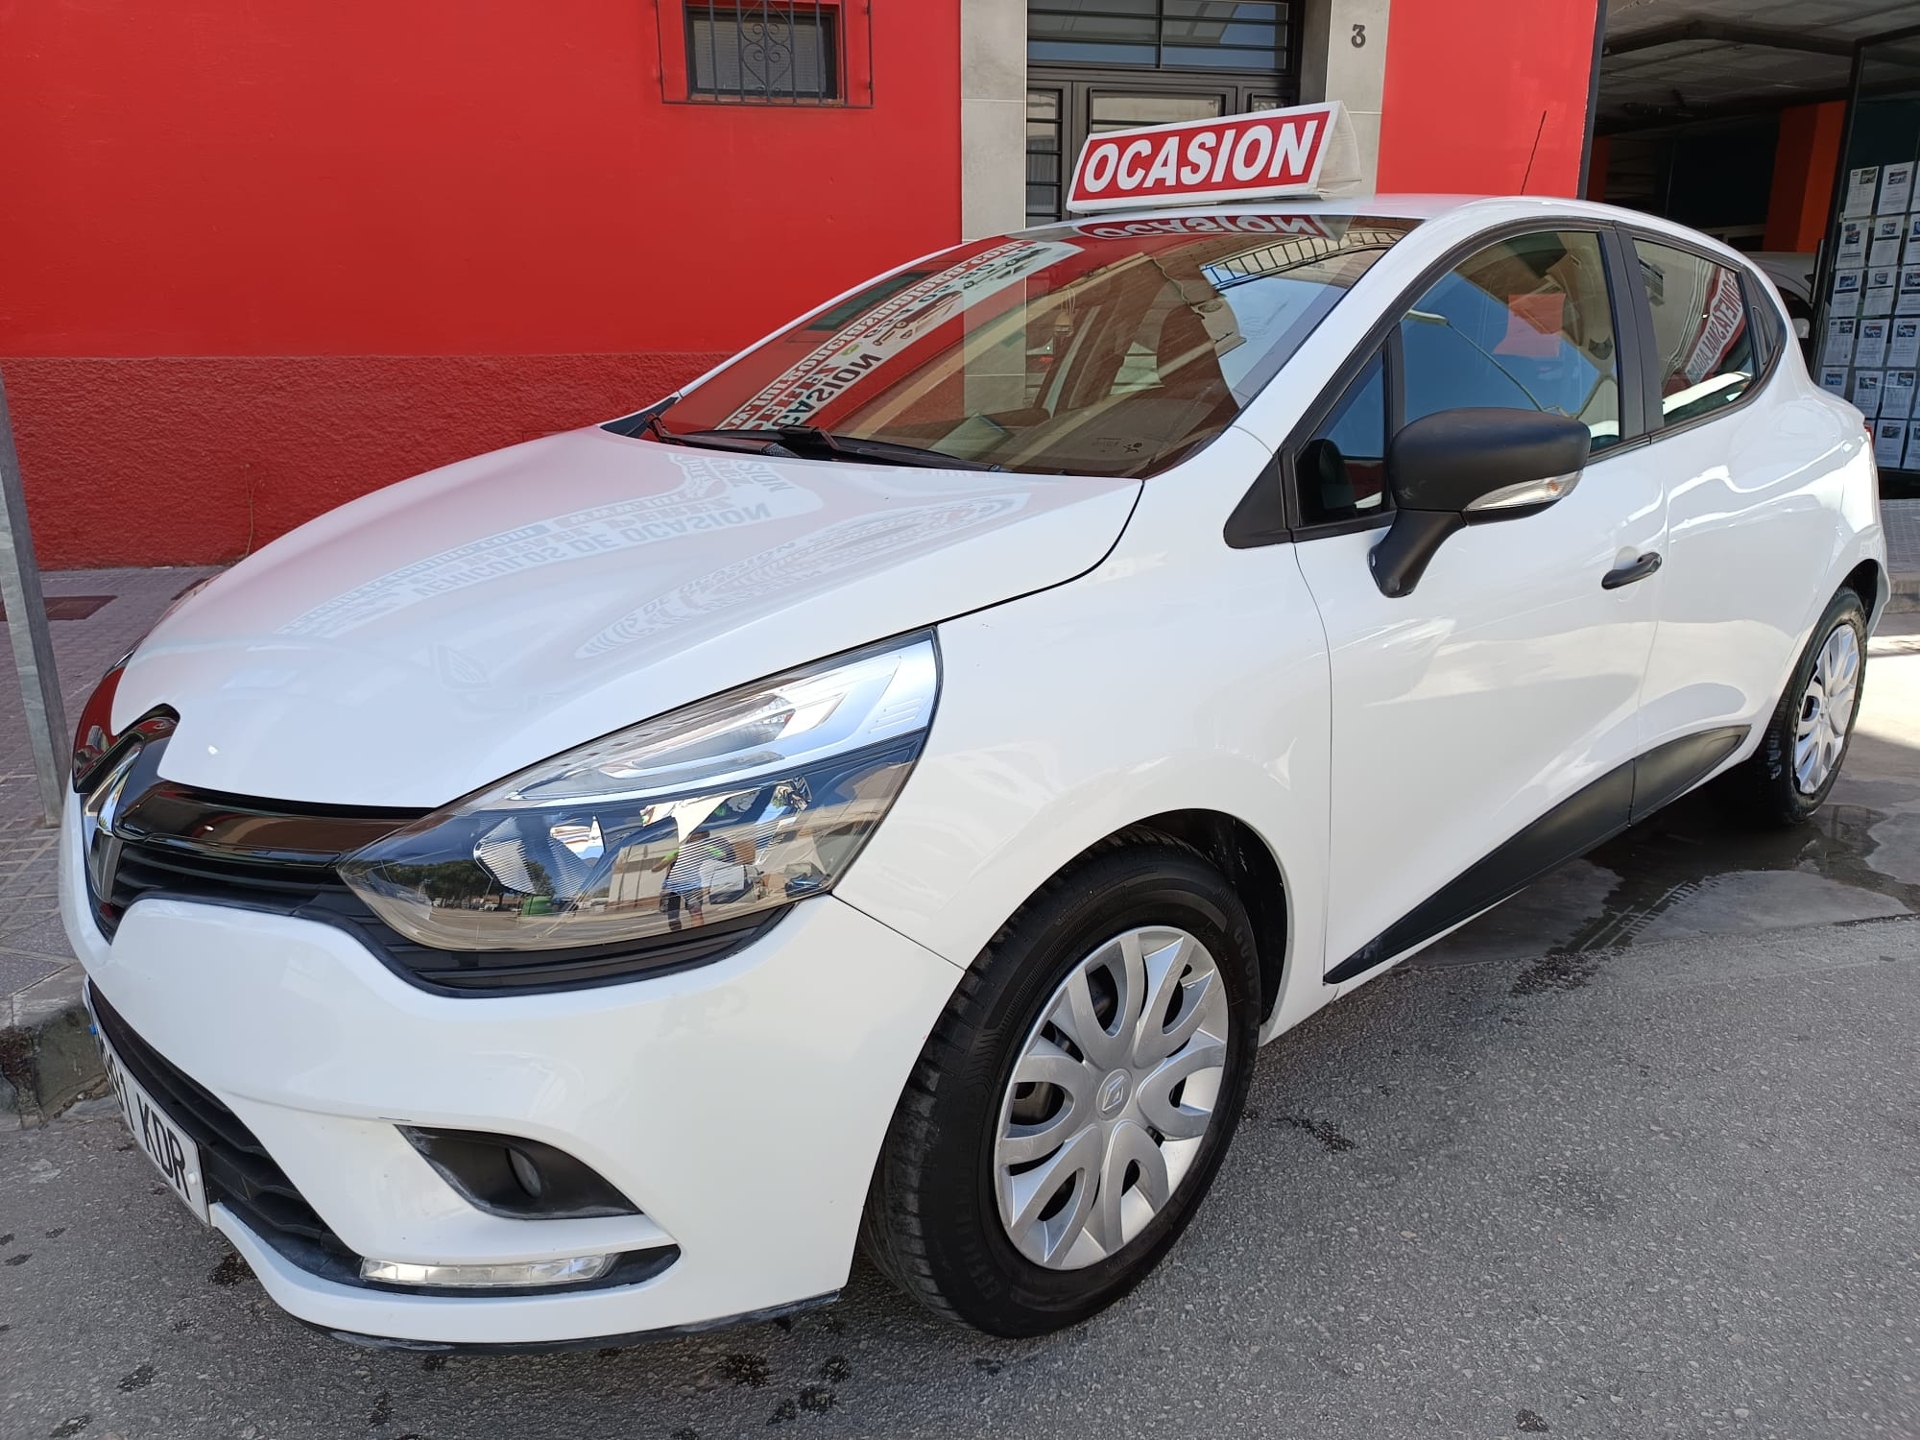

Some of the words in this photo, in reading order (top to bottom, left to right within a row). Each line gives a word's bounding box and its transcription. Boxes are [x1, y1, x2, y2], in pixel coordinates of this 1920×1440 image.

[1351, 24, 1366, 49] 3
[1083, 119, 1318, 193] OCASION
[136, 1093, 192, 1202] KDR
